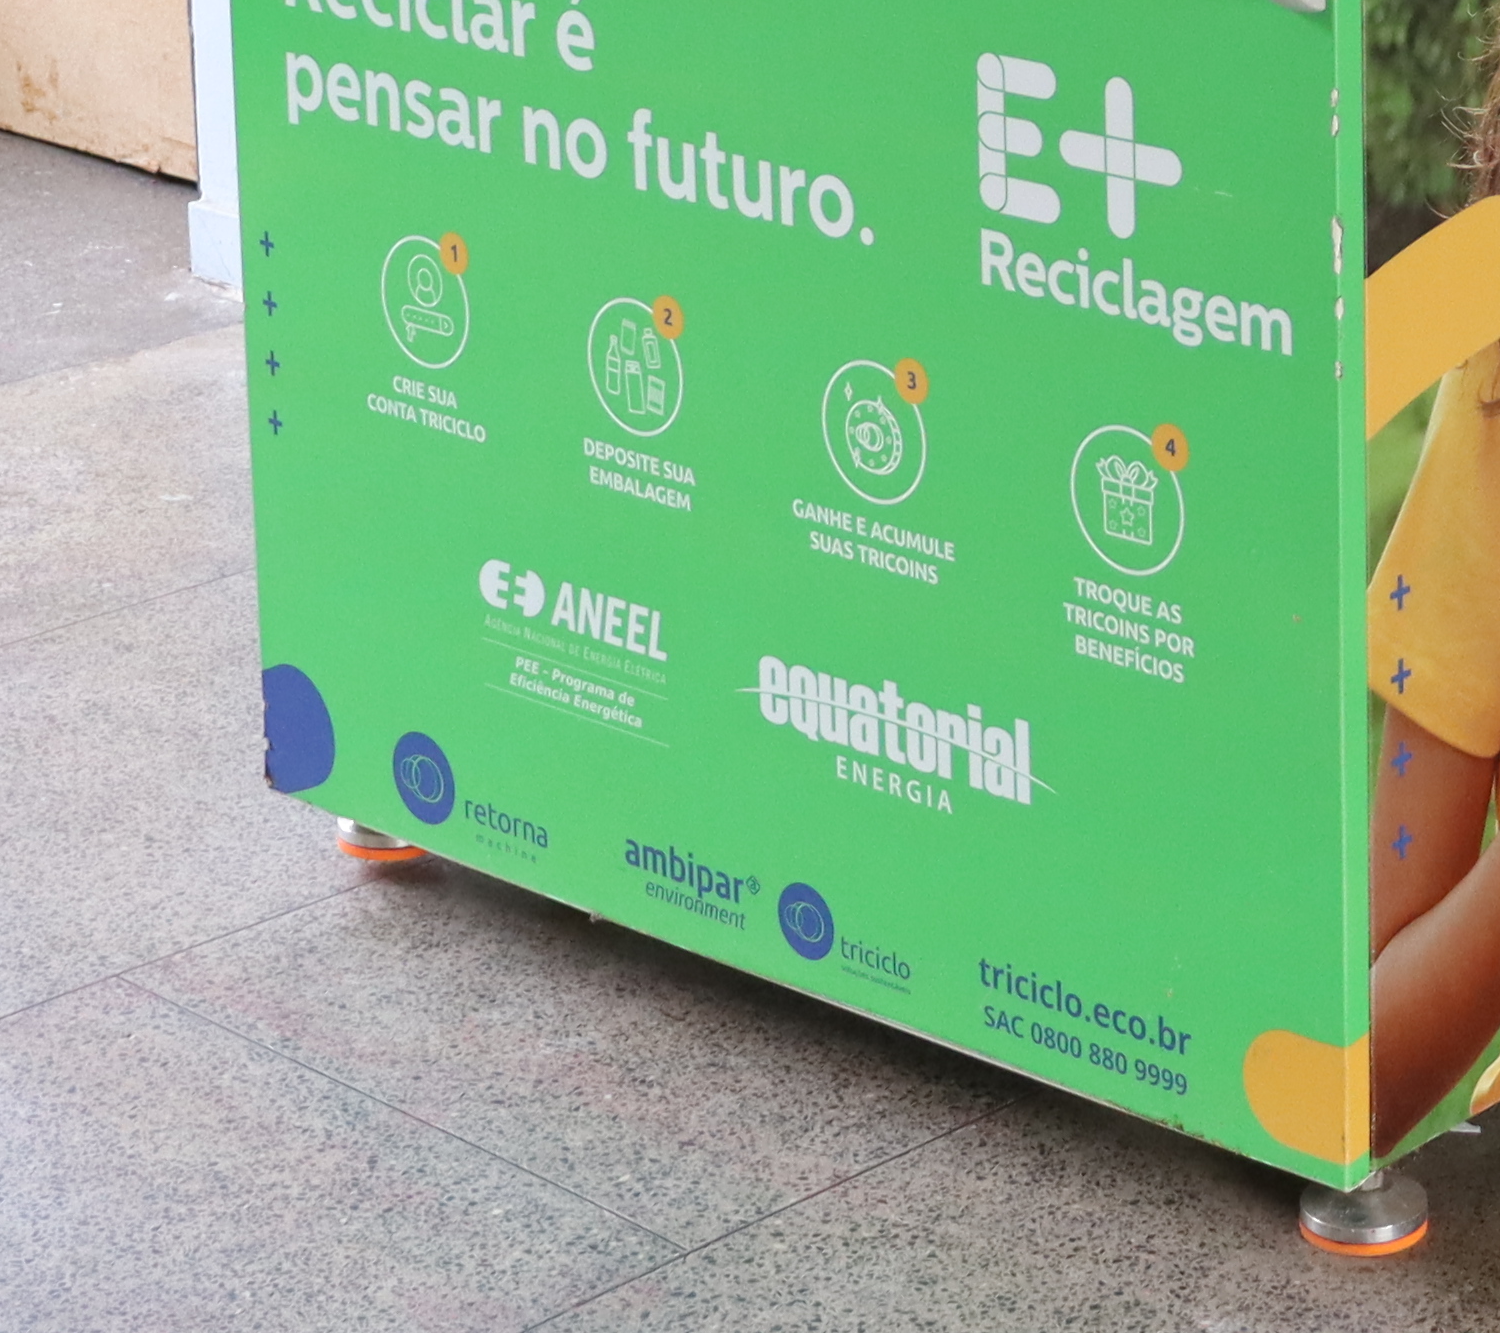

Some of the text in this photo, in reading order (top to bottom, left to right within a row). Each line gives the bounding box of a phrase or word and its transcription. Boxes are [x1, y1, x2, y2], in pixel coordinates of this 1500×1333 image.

[284, 51, 875, 247] pensar no futuro.
[450, 244, 458, 263] 1
[663, 308, 673, 326] 2
[980, 227, 1293, 356] Reciclagem
[392, 375, 458, 410] CRIE SUA
[907, 371, 917, 390] 3
[366, 393, 487, 443] CONTA TRICICLO
[583, 437, 696, 486] DEPOSITE SUA
[1165, 437, 1176, 456] 4
[589, 465, 692, 511] EMBALAGEM
[792, 498, 955, 562] GANHE E ACUMULE
[809, 531, 939, 585] SUAS TRICOINS
[551, 581, 668, 662] ANEEL
[1073, 576, 1182, 624] TROQUE AS
[1063, 602, 1195, 658] TRICOINS POR
[515, 656, 635, 707] PEE Programa de
[1074, 634, 1185, 684] BENEFÍCIOS
[509, 672, 643, 728] Eficiência Energética
[758, 654, 1031, 805] equatorial
[836, 755, 953, 814] ENERGIA
[464, 799, 549, 849] retorna
[625, 838, 744, 904] ambipar
[645, 880, 746, 931] environment
[840, 936, 911, 980] triciclo
[978, 957, 1192, 1055] triciclo.eco.br
[983, 1005, 1188, 1096] SAC 0800 880 9999
